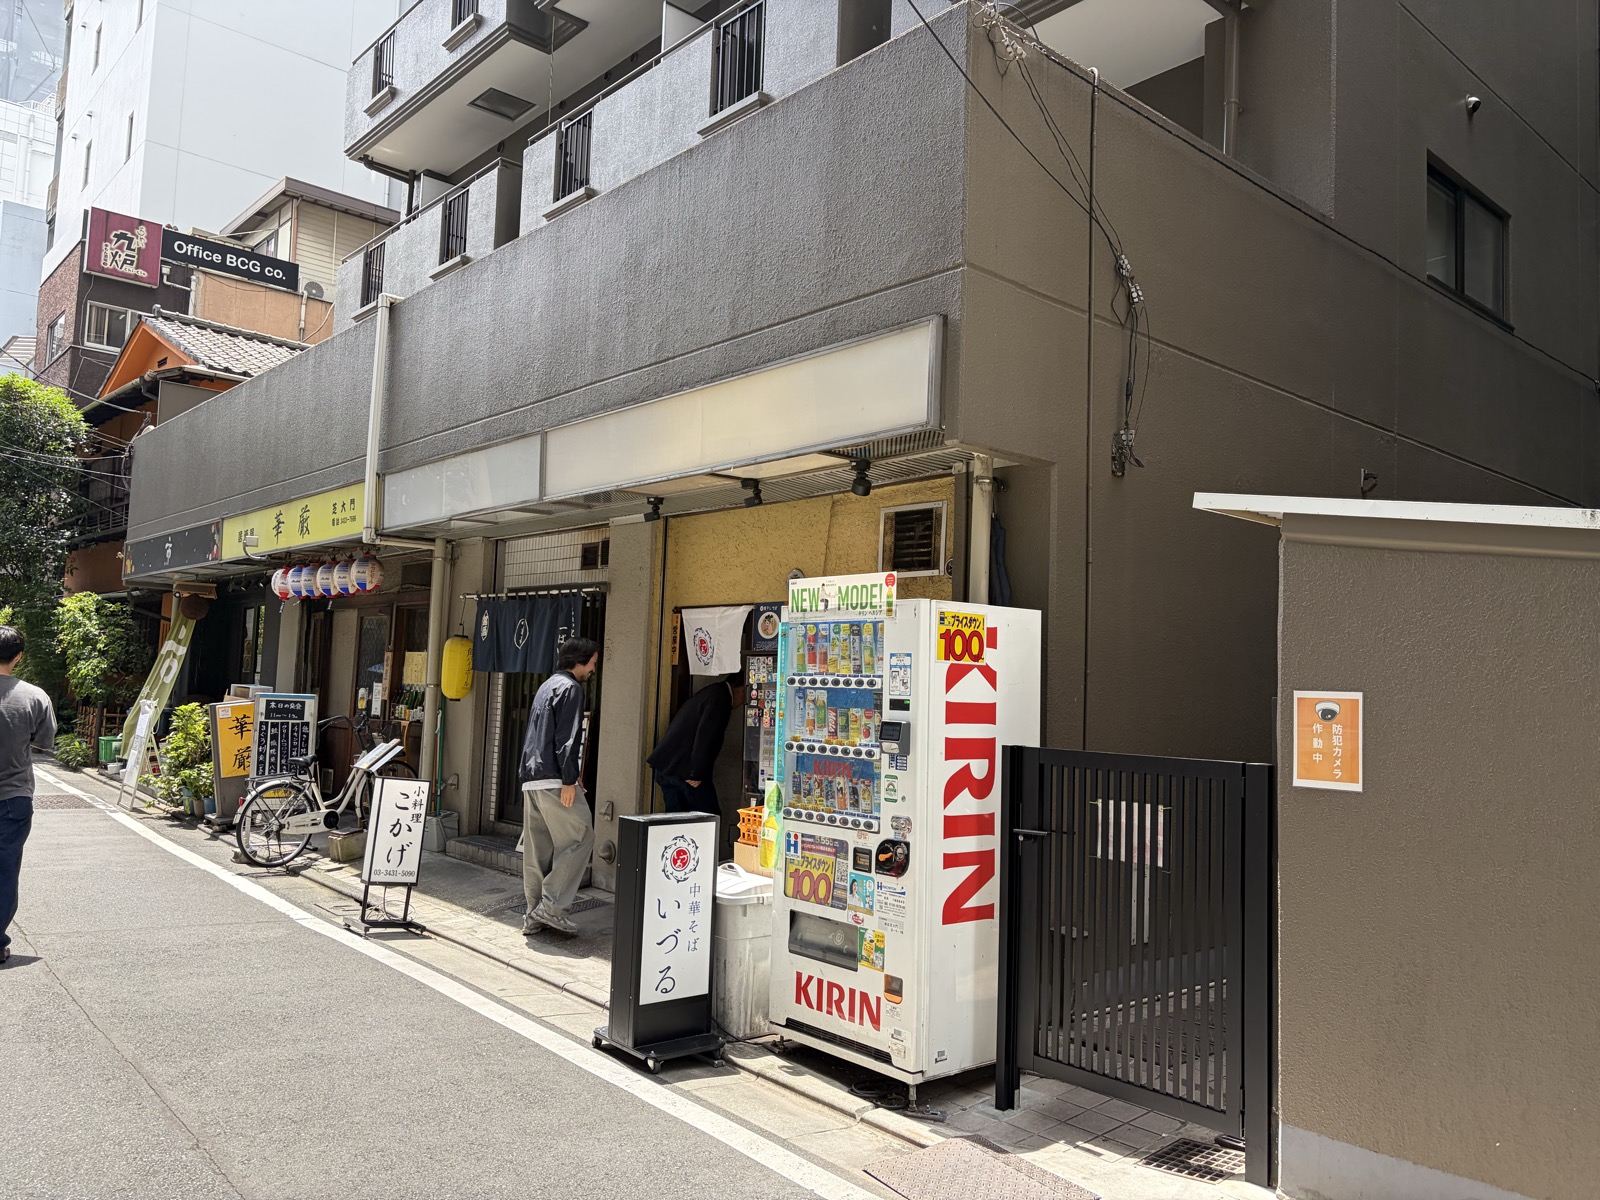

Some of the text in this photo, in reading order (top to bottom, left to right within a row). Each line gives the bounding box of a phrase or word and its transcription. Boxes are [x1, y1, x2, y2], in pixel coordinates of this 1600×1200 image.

[174, 240, 286, 280] Office BCG co.
[331, 498, 356, 515] 芝大門
[791, 583, 883, 613] NEW MODE!
[1312, 723, 1323, 764] 作動中
[1331, 723, 1343, 779] 防犯カメラ
[813, 759, 853, 779] KIRIN
[942, 626, 998, 926] KIRIN
[410, 786, 425, 824] 小料理
[386, 791, 413, 868] こかげ
[373, 868, 416, 878] 03-3431-5090
[687, 882, 701, 953] 中華そば
[654, 898, 682, 994] いづる
[795, 970, 881, 1032] KIRIN
